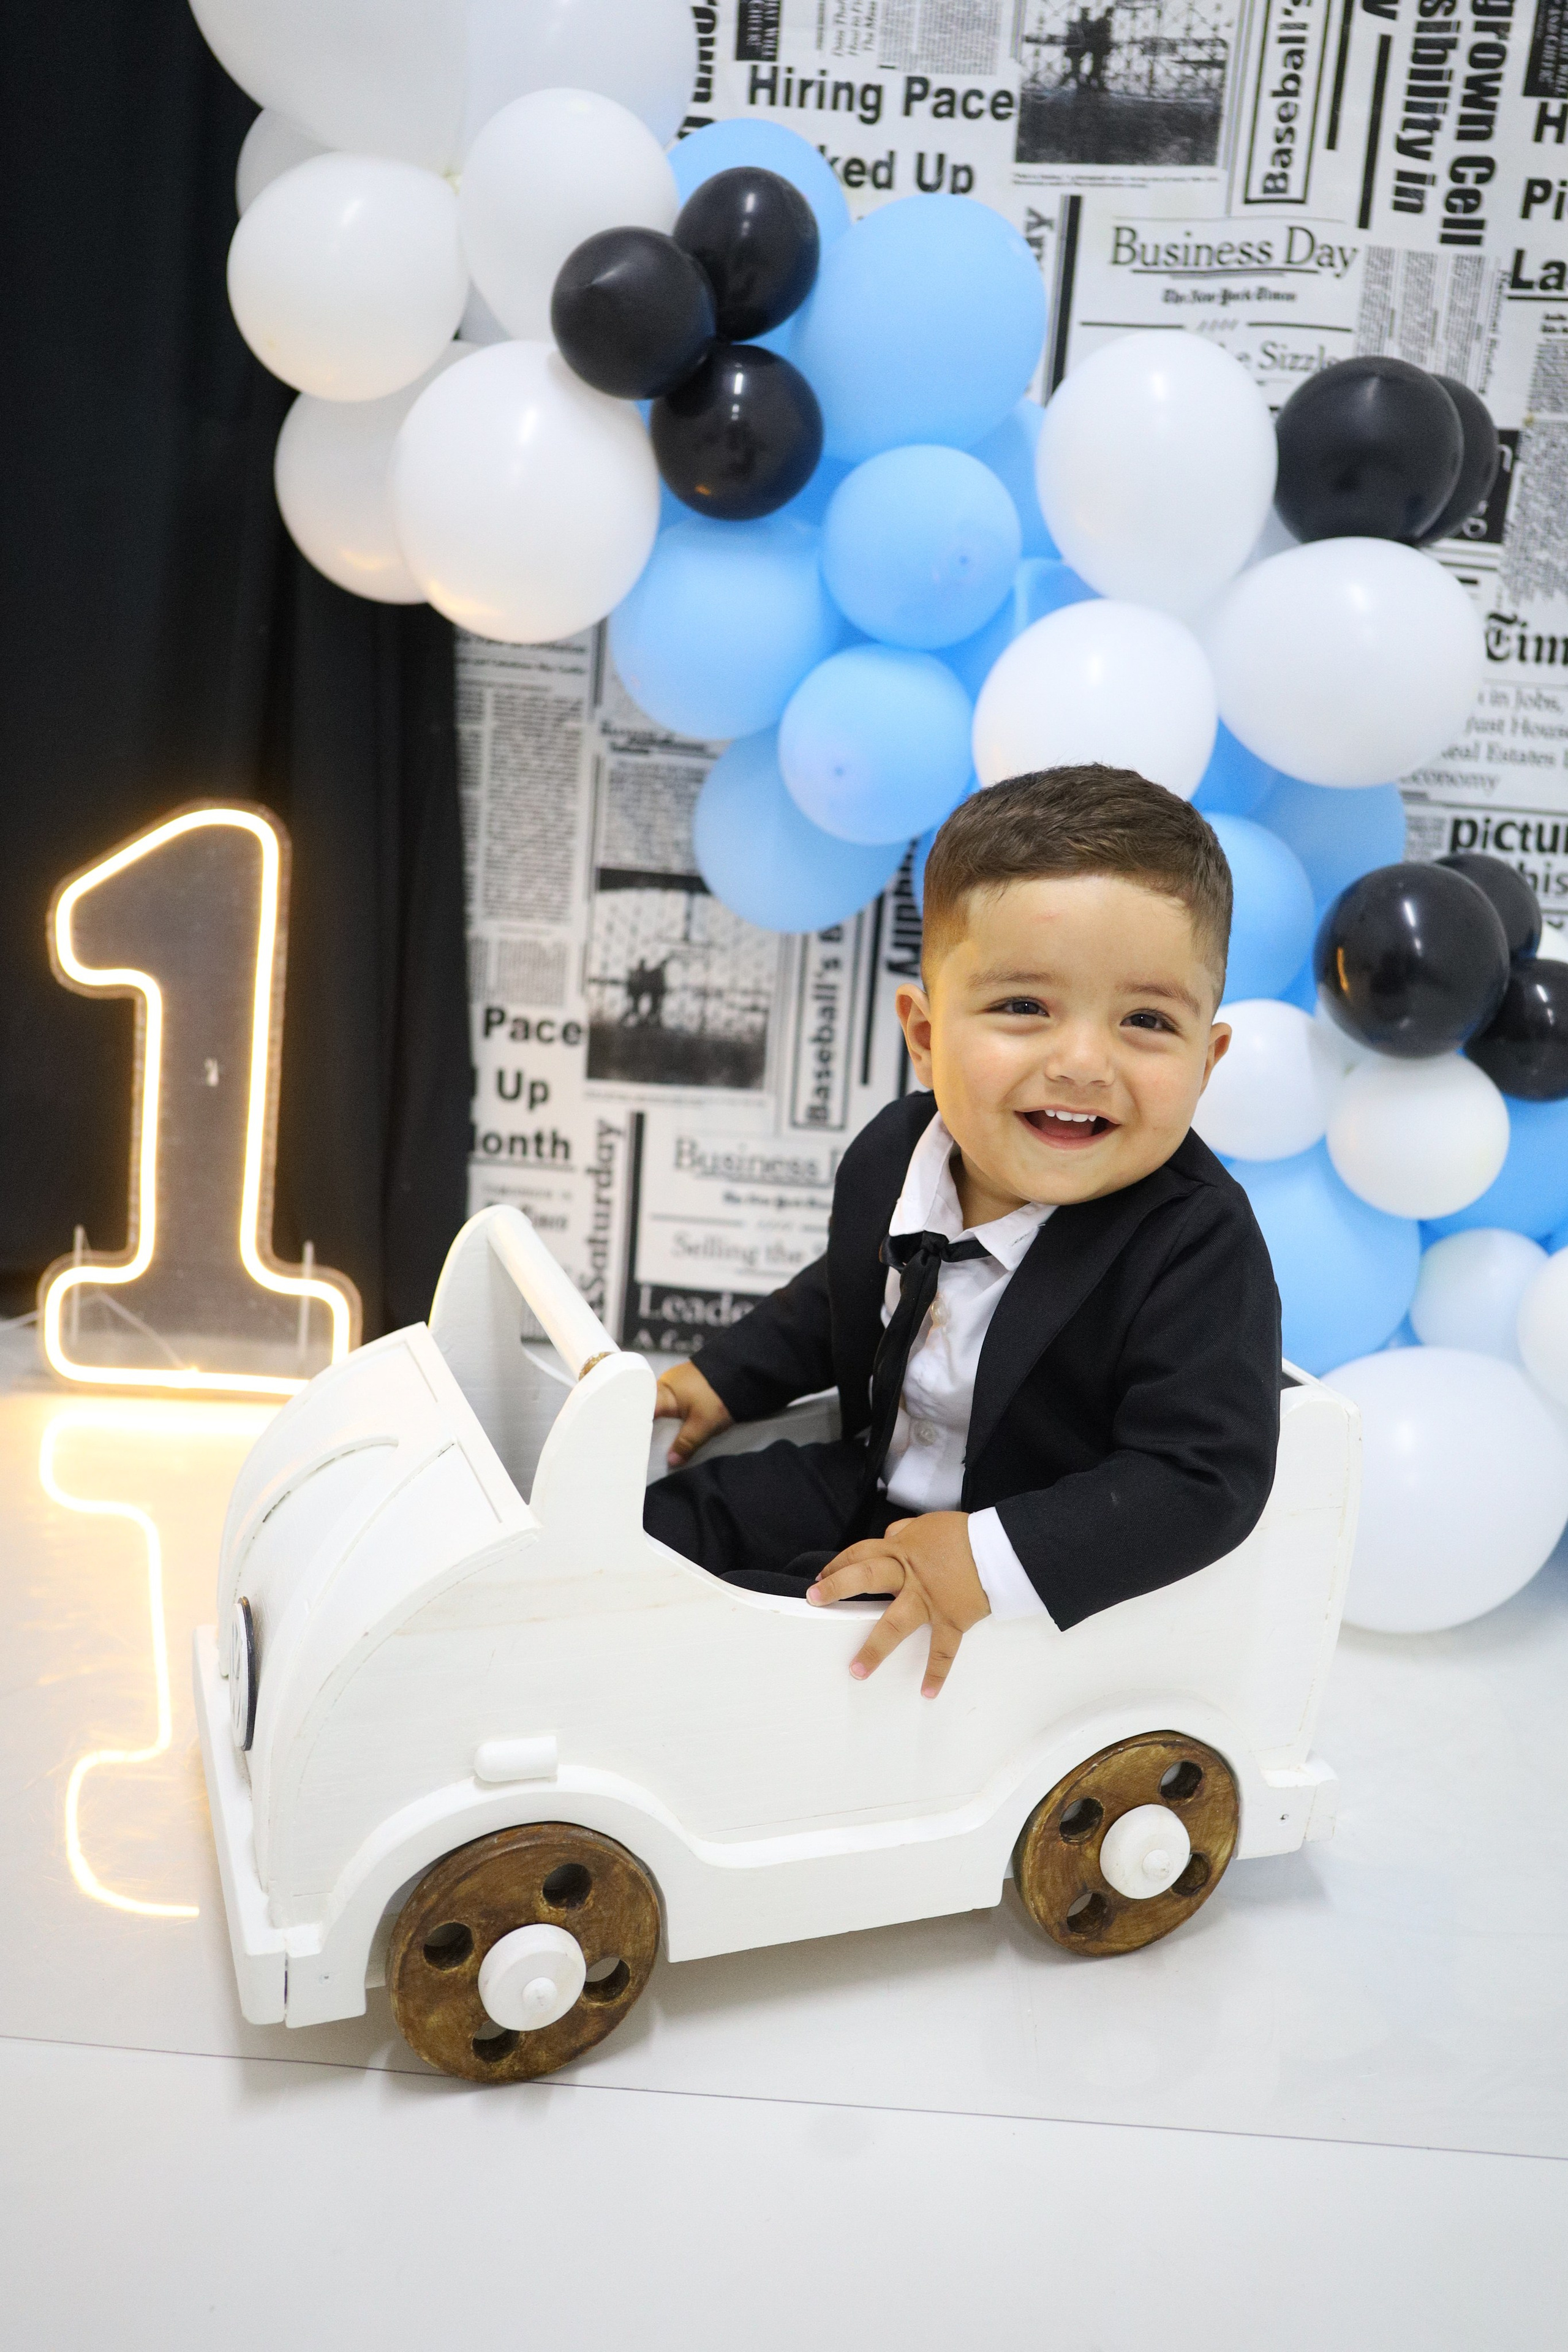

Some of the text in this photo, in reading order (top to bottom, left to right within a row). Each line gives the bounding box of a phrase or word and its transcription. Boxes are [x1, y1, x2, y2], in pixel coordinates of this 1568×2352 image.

[748, 64, 1015, 124] Hiring Pace
[1396, 0, 1460, 160] sibility
[916, 152, 974, 195] Up
[1392, 170, 1436, 213] in
[1439, 156, 1496, 246] Cell
[1521, 178, 1568, 220] Pi
[1111, 226, 1273, 268] Business
[1286, 225, 1359, 279] Day
[1510, 249, 1567, 290] La
[1484, 612, 1568, 666] Tim
[1441, 740, 1480, 762] eal
[1399, 769, 1501, 796] conomy
[484, 1006, 582, 1046] Pace
[805, 956, 842, 1123] Baseball's
[497, 1069, 549, 1111] Up
[473, 1126, 570, 1160] onth
[675, 1137, 818, 1177] Business
[578, 1120, 624, 1292] Saturday
